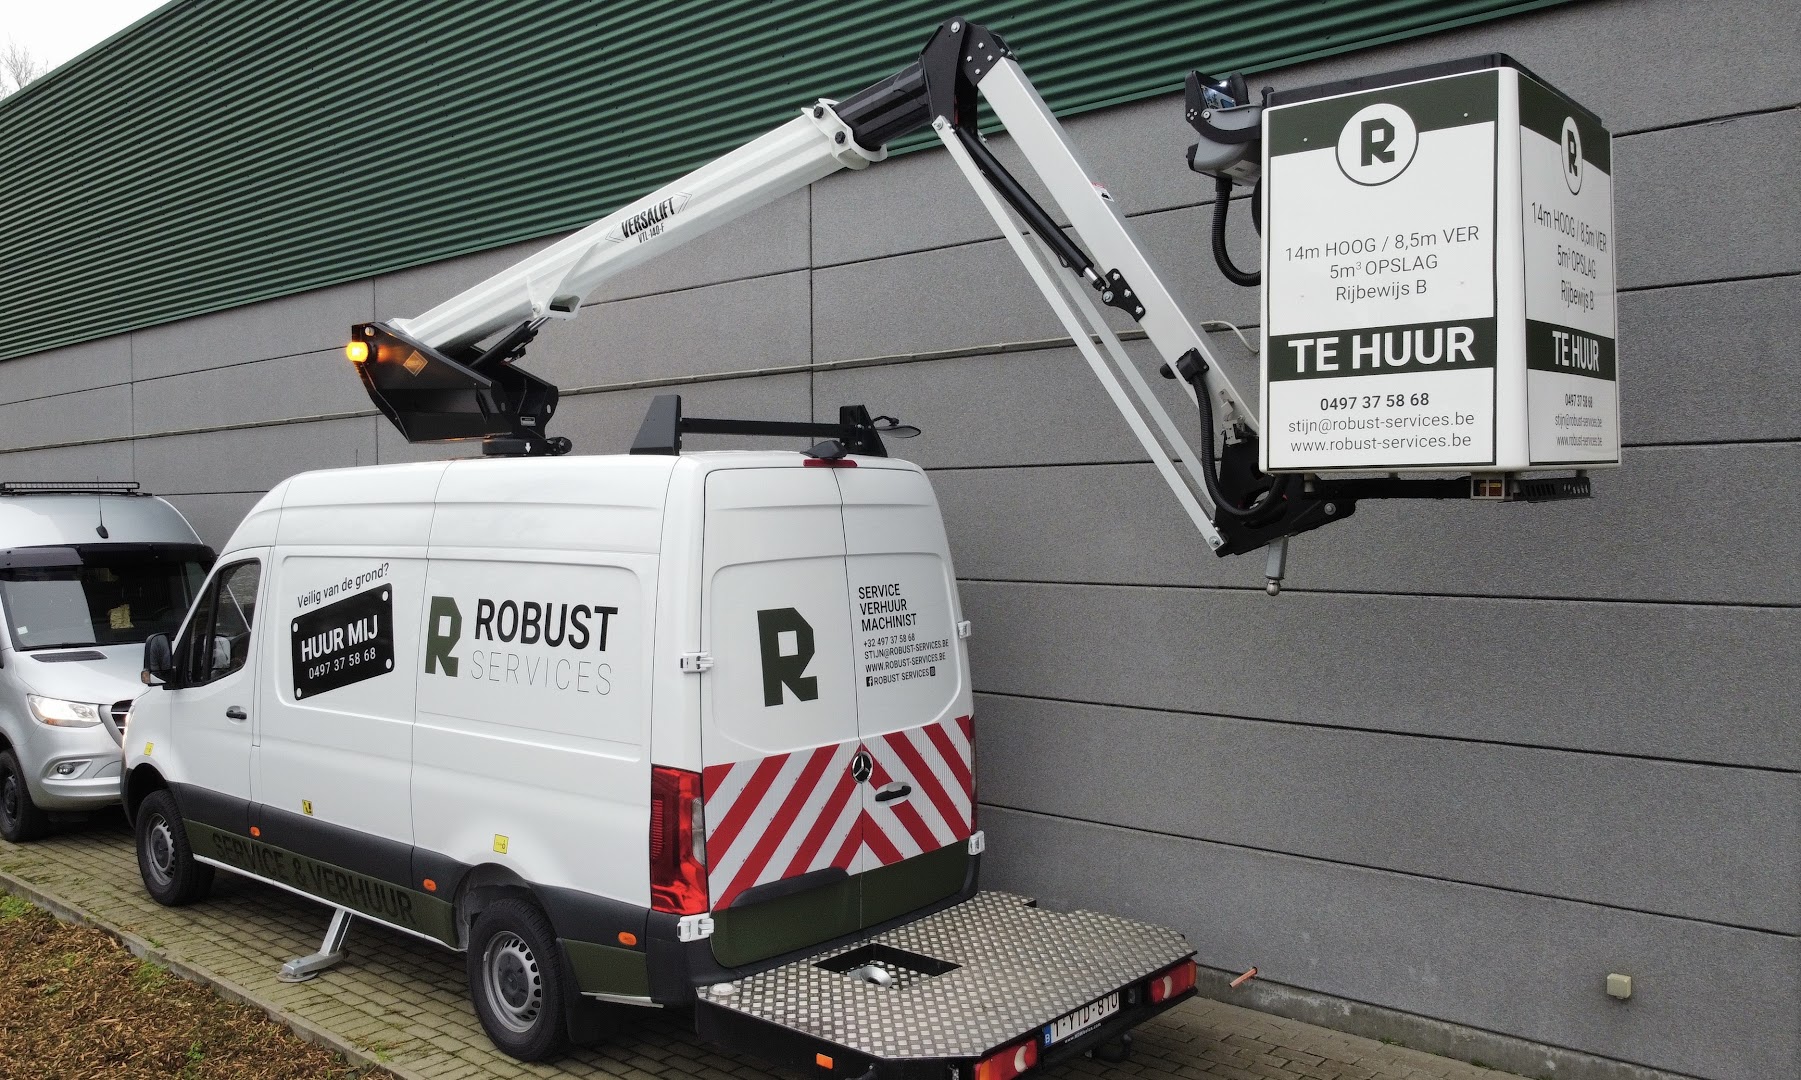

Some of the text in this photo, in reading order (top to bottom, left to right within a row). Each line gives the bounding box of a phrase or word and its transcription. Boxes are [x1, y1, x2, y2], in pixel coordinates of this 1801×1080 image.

[1361, 117, 1395, 167] R
[1567, 129, 1578, 177] R
[621, 196, 675, 238] VERSALIFT
[1531, 201, 1552, 228] 14m
[1553, 209, 1575, 238] HOOG
[1580, 222, 1595, 249] 8,5m
[1595, 230, 1607, 253] VER
[1285, 225, 1480, 262] 14m HOOG / 8,5m VER
[1365, 254, 1438, 276] OPSLAG
[1571, 250, 1596, 280] OPSLAG
[1335, 279, 1427, 301] Rijbewijs B
[1561, 279, 1594, 313] Rijbewijs B
[1288, 326, 1475, 373] TE HUUR
[1552, 330, 1600, 372] TE HUUR
[1320, 392, 1429, 412] 0497 37 58 68
[1288, 412, 1475, 435] stijn@robust-services.be
[1290, 433, 1472, 452] www.robust-services.be
[297, 562, 390, 608] Veilig van de grond?
[858, 583, 901, 600] SERVICE
[859, 599, 907, 616] VERHUUR
[861, 613, 917, 632] MACHINIST
[301, 614, 379, 663] HUUR MIJ
[424, 595, 463, 678] R
[474, 598, 618, 652] ROBUST
[863, 633, 916, 648] +32 497 37 58 68
[308, 647, 376, 680] 0497 37 58 68
[757, 607, 819, 707] R
[864, 639, 949, 660] STIJN@ROBUST-SERVICES.BE
[865, 652, 946, 673] WWW.ROBUST-SERVICES.BE
[470, 650, 612, 696] SERVICES
[873, 673, 900, 686] ROBUST
[901, 668, 930, 681] SERVICES
[212, 833, 417, 925] SERVICE & VERHUUR
